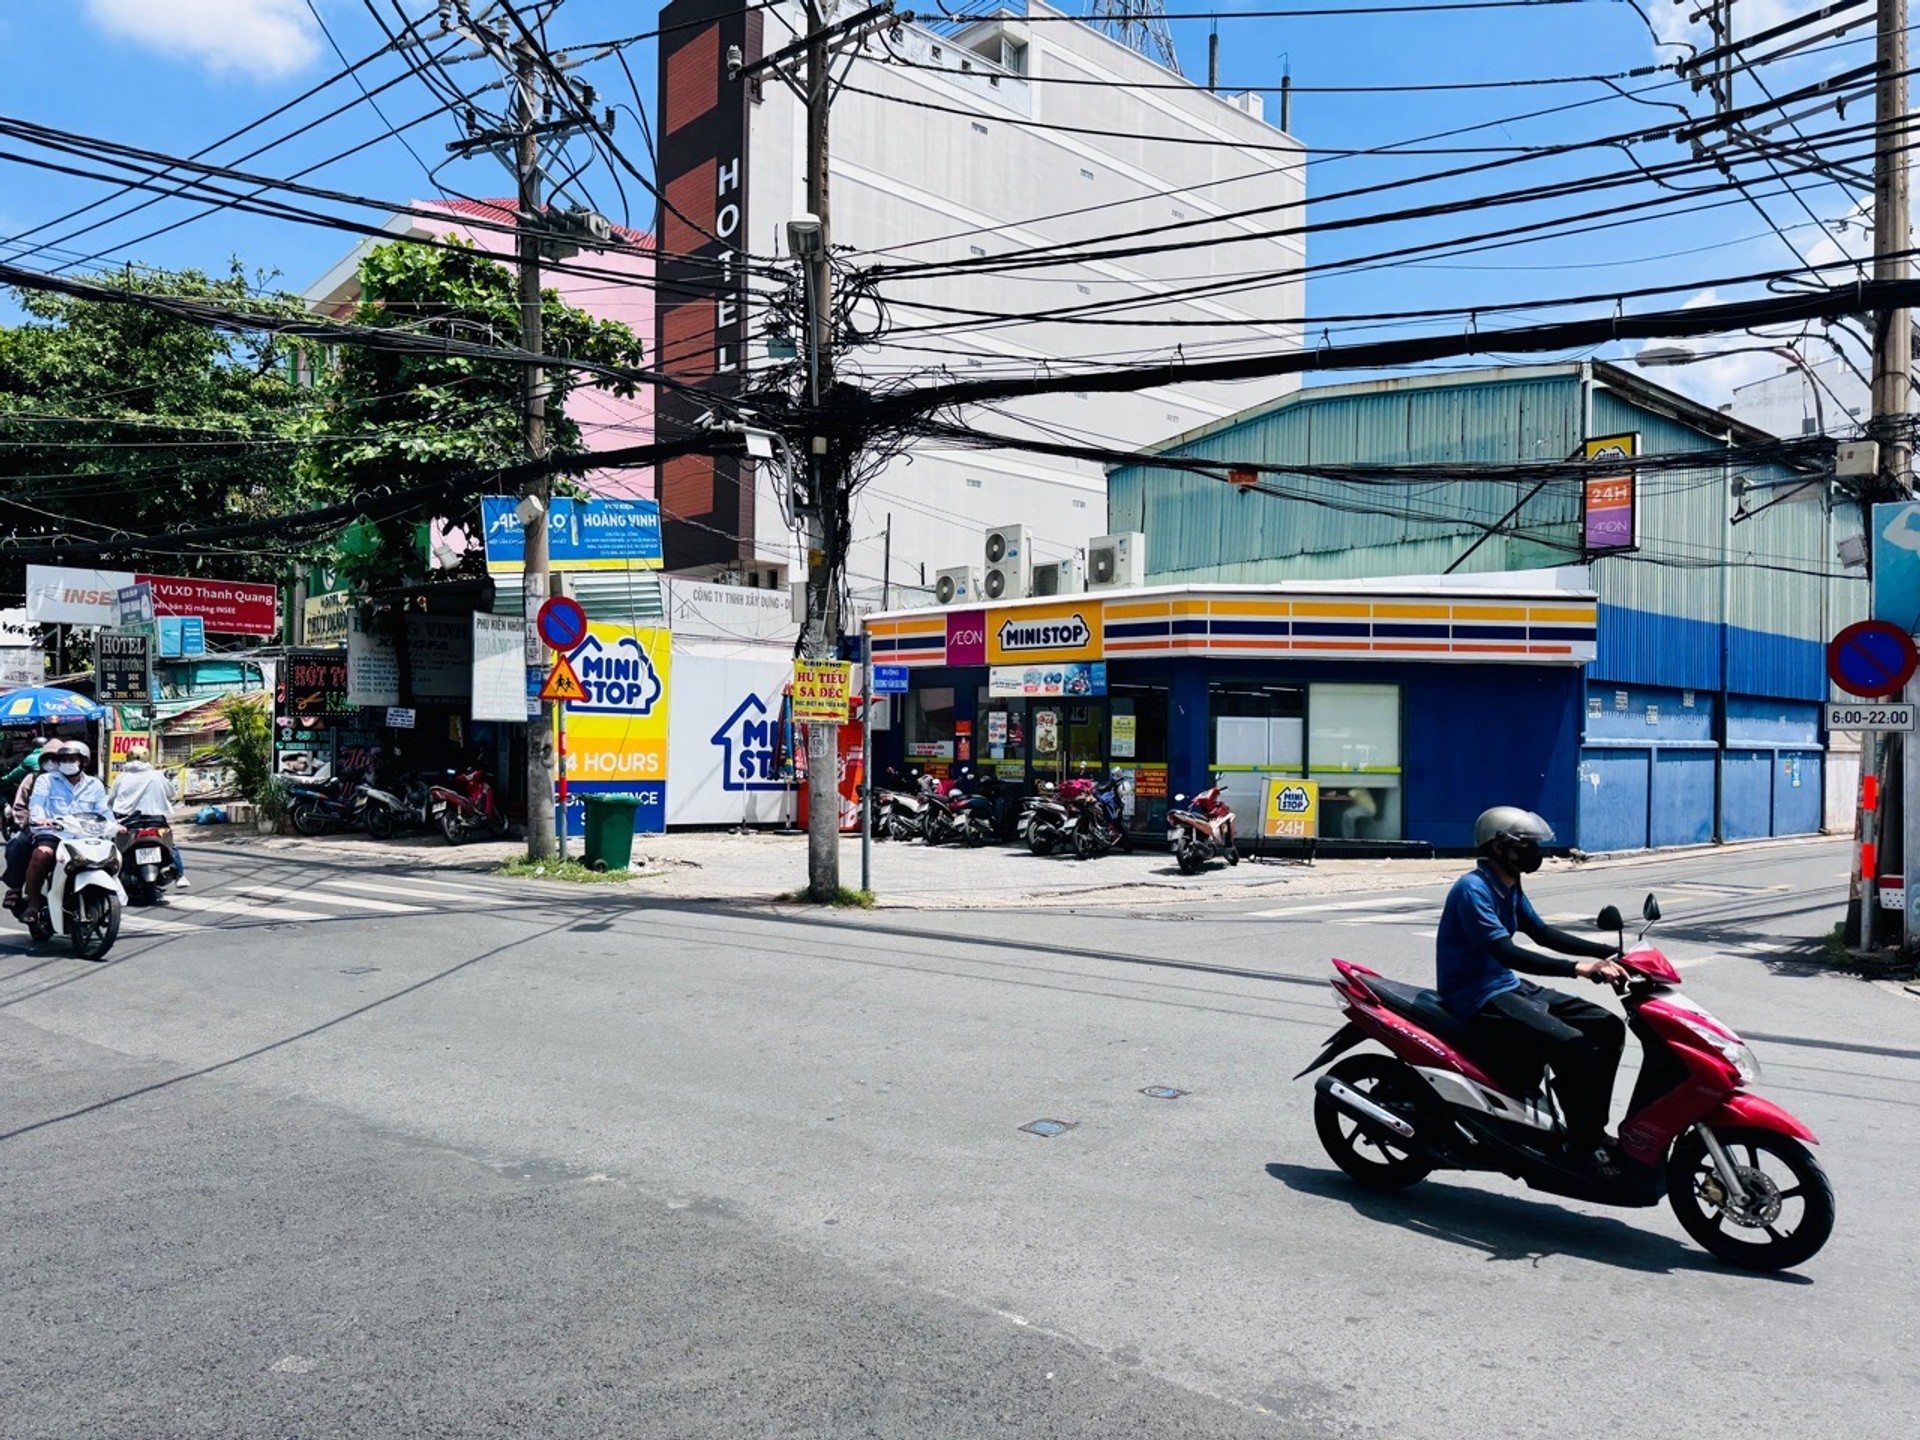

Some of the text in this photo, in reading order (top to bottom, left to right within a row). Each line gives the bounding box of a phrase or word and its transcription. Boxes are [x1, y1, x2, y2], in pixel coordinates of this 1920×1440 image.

[717, 157, 740, 374] HOTEL
[1591, 485, 1628, 503] 24H
[583, 510, 658, 528] HOÀNG VINH
[62, 588, 117, 606] INSE
[161, 585, 193, 597] VLXD
[196, 587, 233, 600] Thanh
[235, 590, 274, 606] Quang
[692, 586, 713, 603] CÔNG
[714, 591, 724, 603] TY
[725, 592, 744, 606] TNHH
[745, 592, 760, 607] XÂY
[760, 596, 780, 610] DỰNG
[476, 617, 490, 631] PHỤ
[490, 616, 506, 632] KIỆN
[1006, 625, 1084, 647] MINISTOP
[101, 636, 145, 655] HOTEL
[582, 655, 640, 681] MINI
[796, 668, 847, 684] HỦ TIẾU
[580, 681, 642, 705] STOP
[799, 686, 816, 697] SA
[1832, 710, 1908, 725] 6:00-22:00
[743, 719, 779, 748] MI
[584, 752, 659, 772] HOURS
[1282, 800, 1304, 809] STOP
[1284, 793, 1303, 801] MINI
[1275, 820, 1305, 835] 24H
